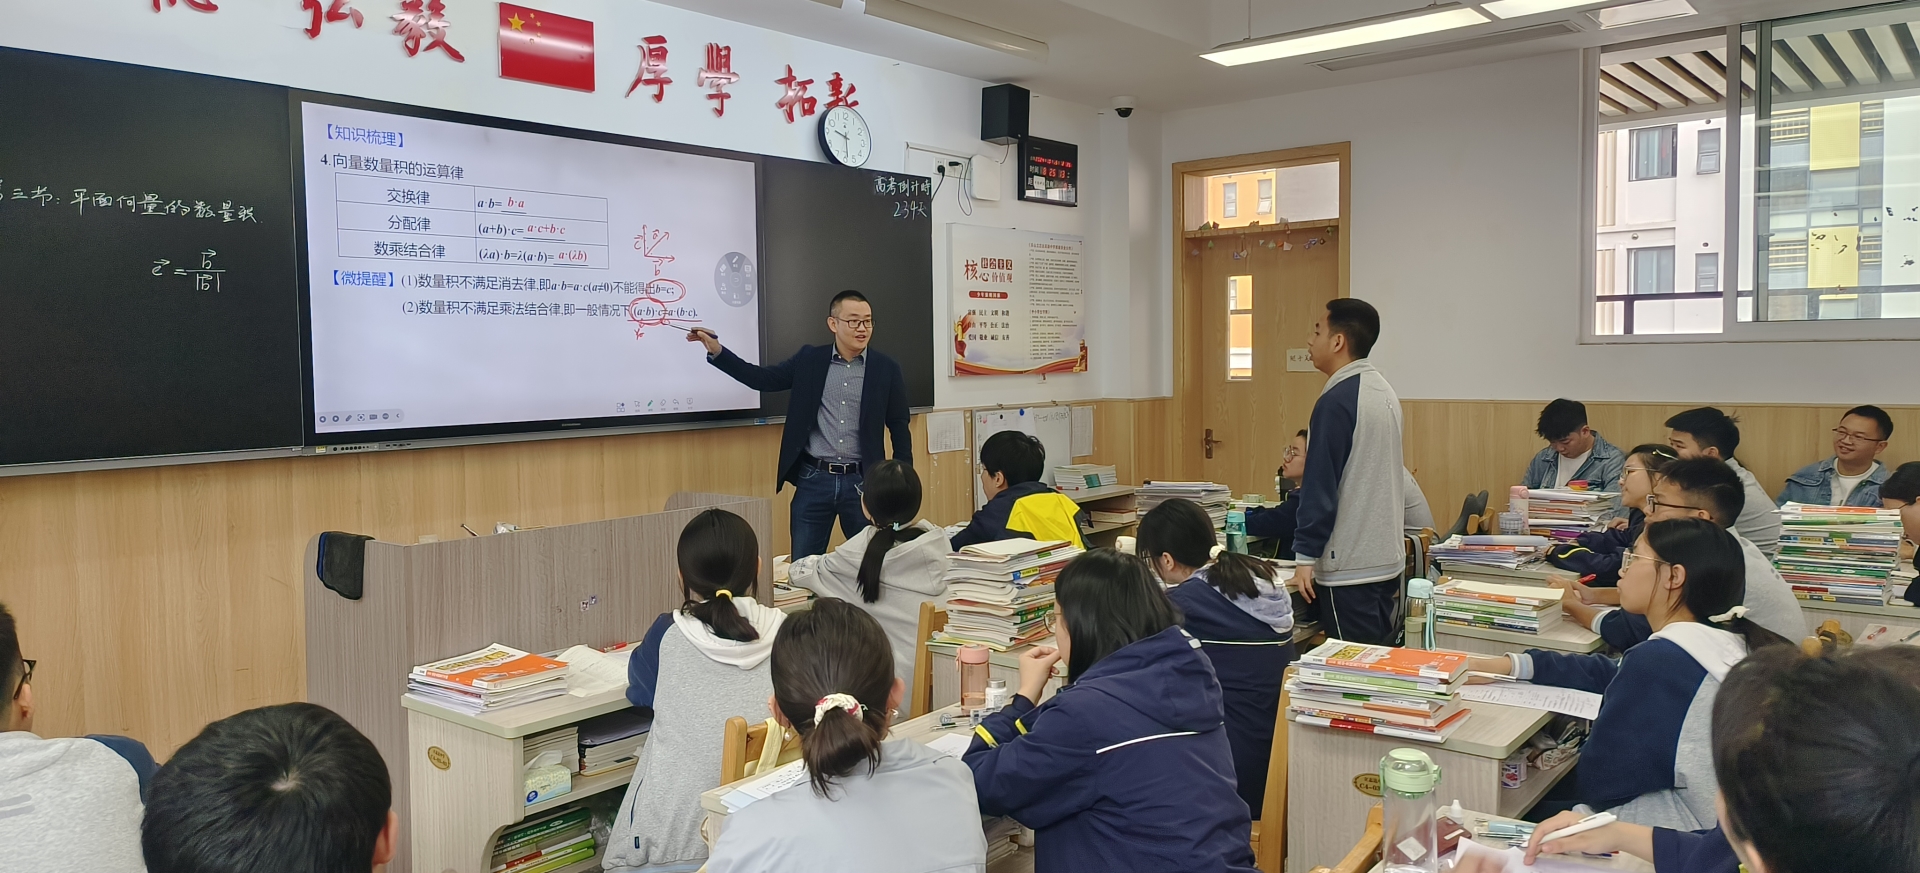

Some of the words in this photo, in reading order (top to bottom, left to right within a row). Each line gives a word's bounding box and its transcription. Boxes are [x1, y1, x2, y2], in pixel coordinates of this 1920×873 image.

[325, 123, 405, 149] 【知识梳理】
[320, 153, 465, 180] 4.向量数量积的运算律
[387, 188, 430, 205] 交换律
[893, 200, 928, 220] 234天
[388, 215, 431, 231] 分配律
[374, 240, 446, 259] 数乘结合律
[331, 269, 395, 288] 【微提醒】
